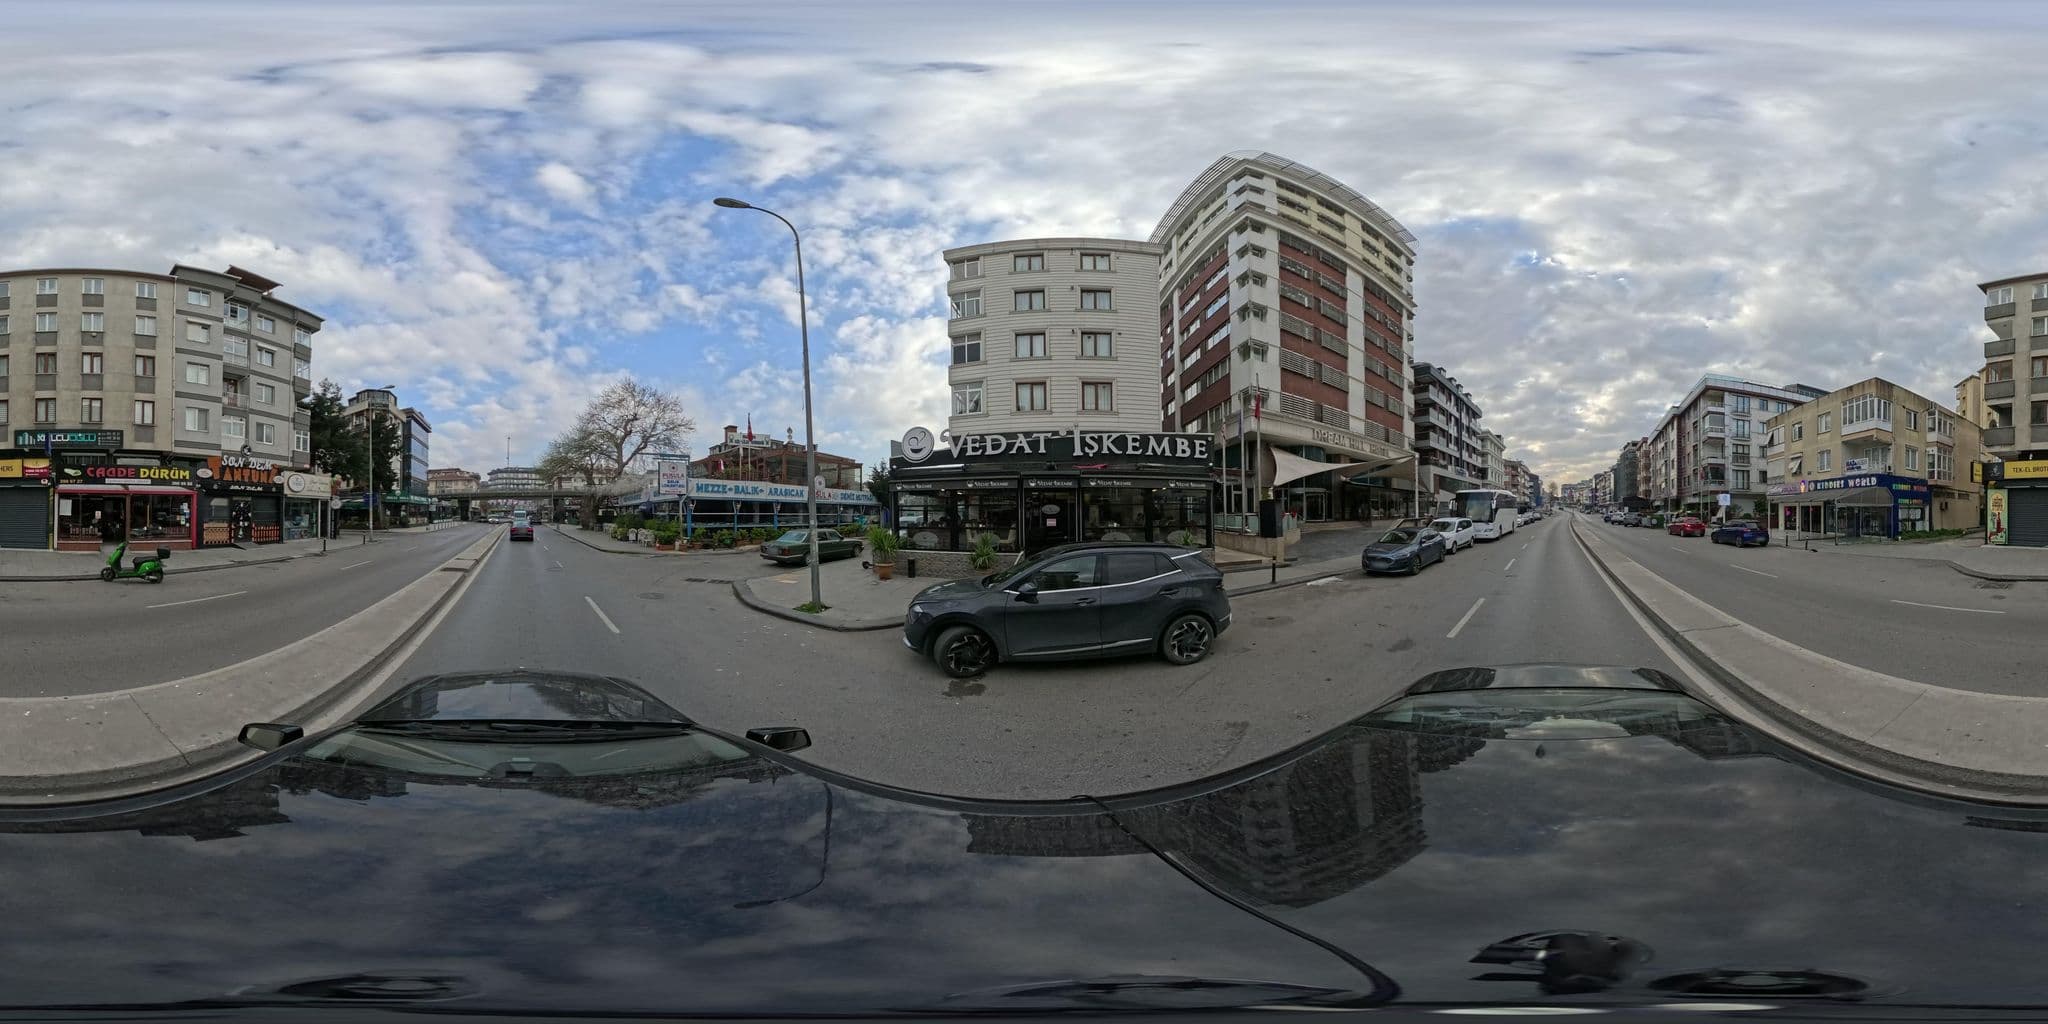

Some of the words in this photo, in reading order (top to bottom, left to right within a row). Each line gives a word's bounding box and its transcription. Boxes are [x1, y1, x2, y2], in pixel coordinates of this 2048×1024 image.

[940, 428, 1052, 459] VEDAT
[1312, 428, 1346, 447] DREAM
[221, 454, 245, 468] SON
[248, 457, 273, 471] DEM
[139, 466, 190, 480] DÜRÜM
[1847, 477, 1877, 488] WORLD
